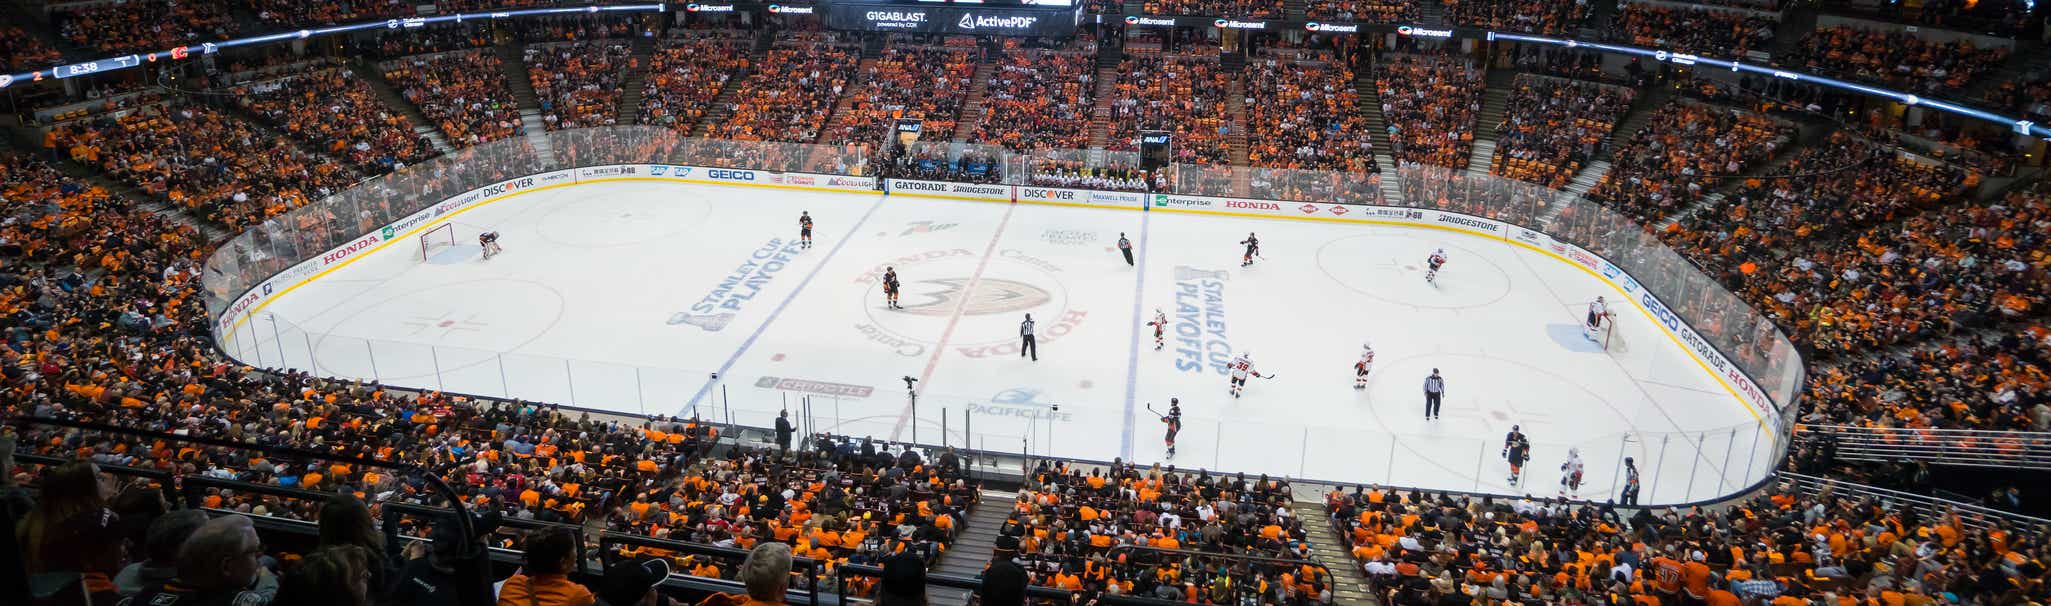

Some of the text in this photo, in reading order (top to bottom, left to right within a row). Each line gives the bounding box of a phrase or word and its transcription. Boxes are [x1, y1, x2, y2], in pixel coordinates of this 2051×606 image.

[701, 4, 733, 12] Microsemi
[1139, 17, 1175, 26] Microsemi
[1229, 20, 1265, 29] Microsemi
[1320, 23, 1357, 32] Microsemi
[1412, 27, 1452, 37] Microsemi
[69, 62, 98, 75] 8:38
[708, 169, 754, 181] GEICO
[483, 177, 533, 198] DISCOVER
[895, 181, 947, 192] GATORADE
[953, 184, 1005, 196] BRIDGESTONE
[1024, 188, 1073, 200] DISCOVER
[1225, 200, 1280, 211] HONDA
[1438, 214, 1498, 232] BRIDGESTONE
[323, 234, 380, 265] HONDA
[692, 238, 784, 313] STANLEY CUP
[719, 240, 802, 312] PLAYOFFS
[222, 293, 260, 329] HONDA
[1642, 293, 1679, 332] GEICO
[1175, 282, 1203, 373] PLAYOFFS
[1201, 280, 1232, 376] STANLEY CUP
[1681, 328, 1727, 373] GATORADE
[1728, 369, 1772, 419] HONDA
[968, 402, 1033, 418] PACIFIC
